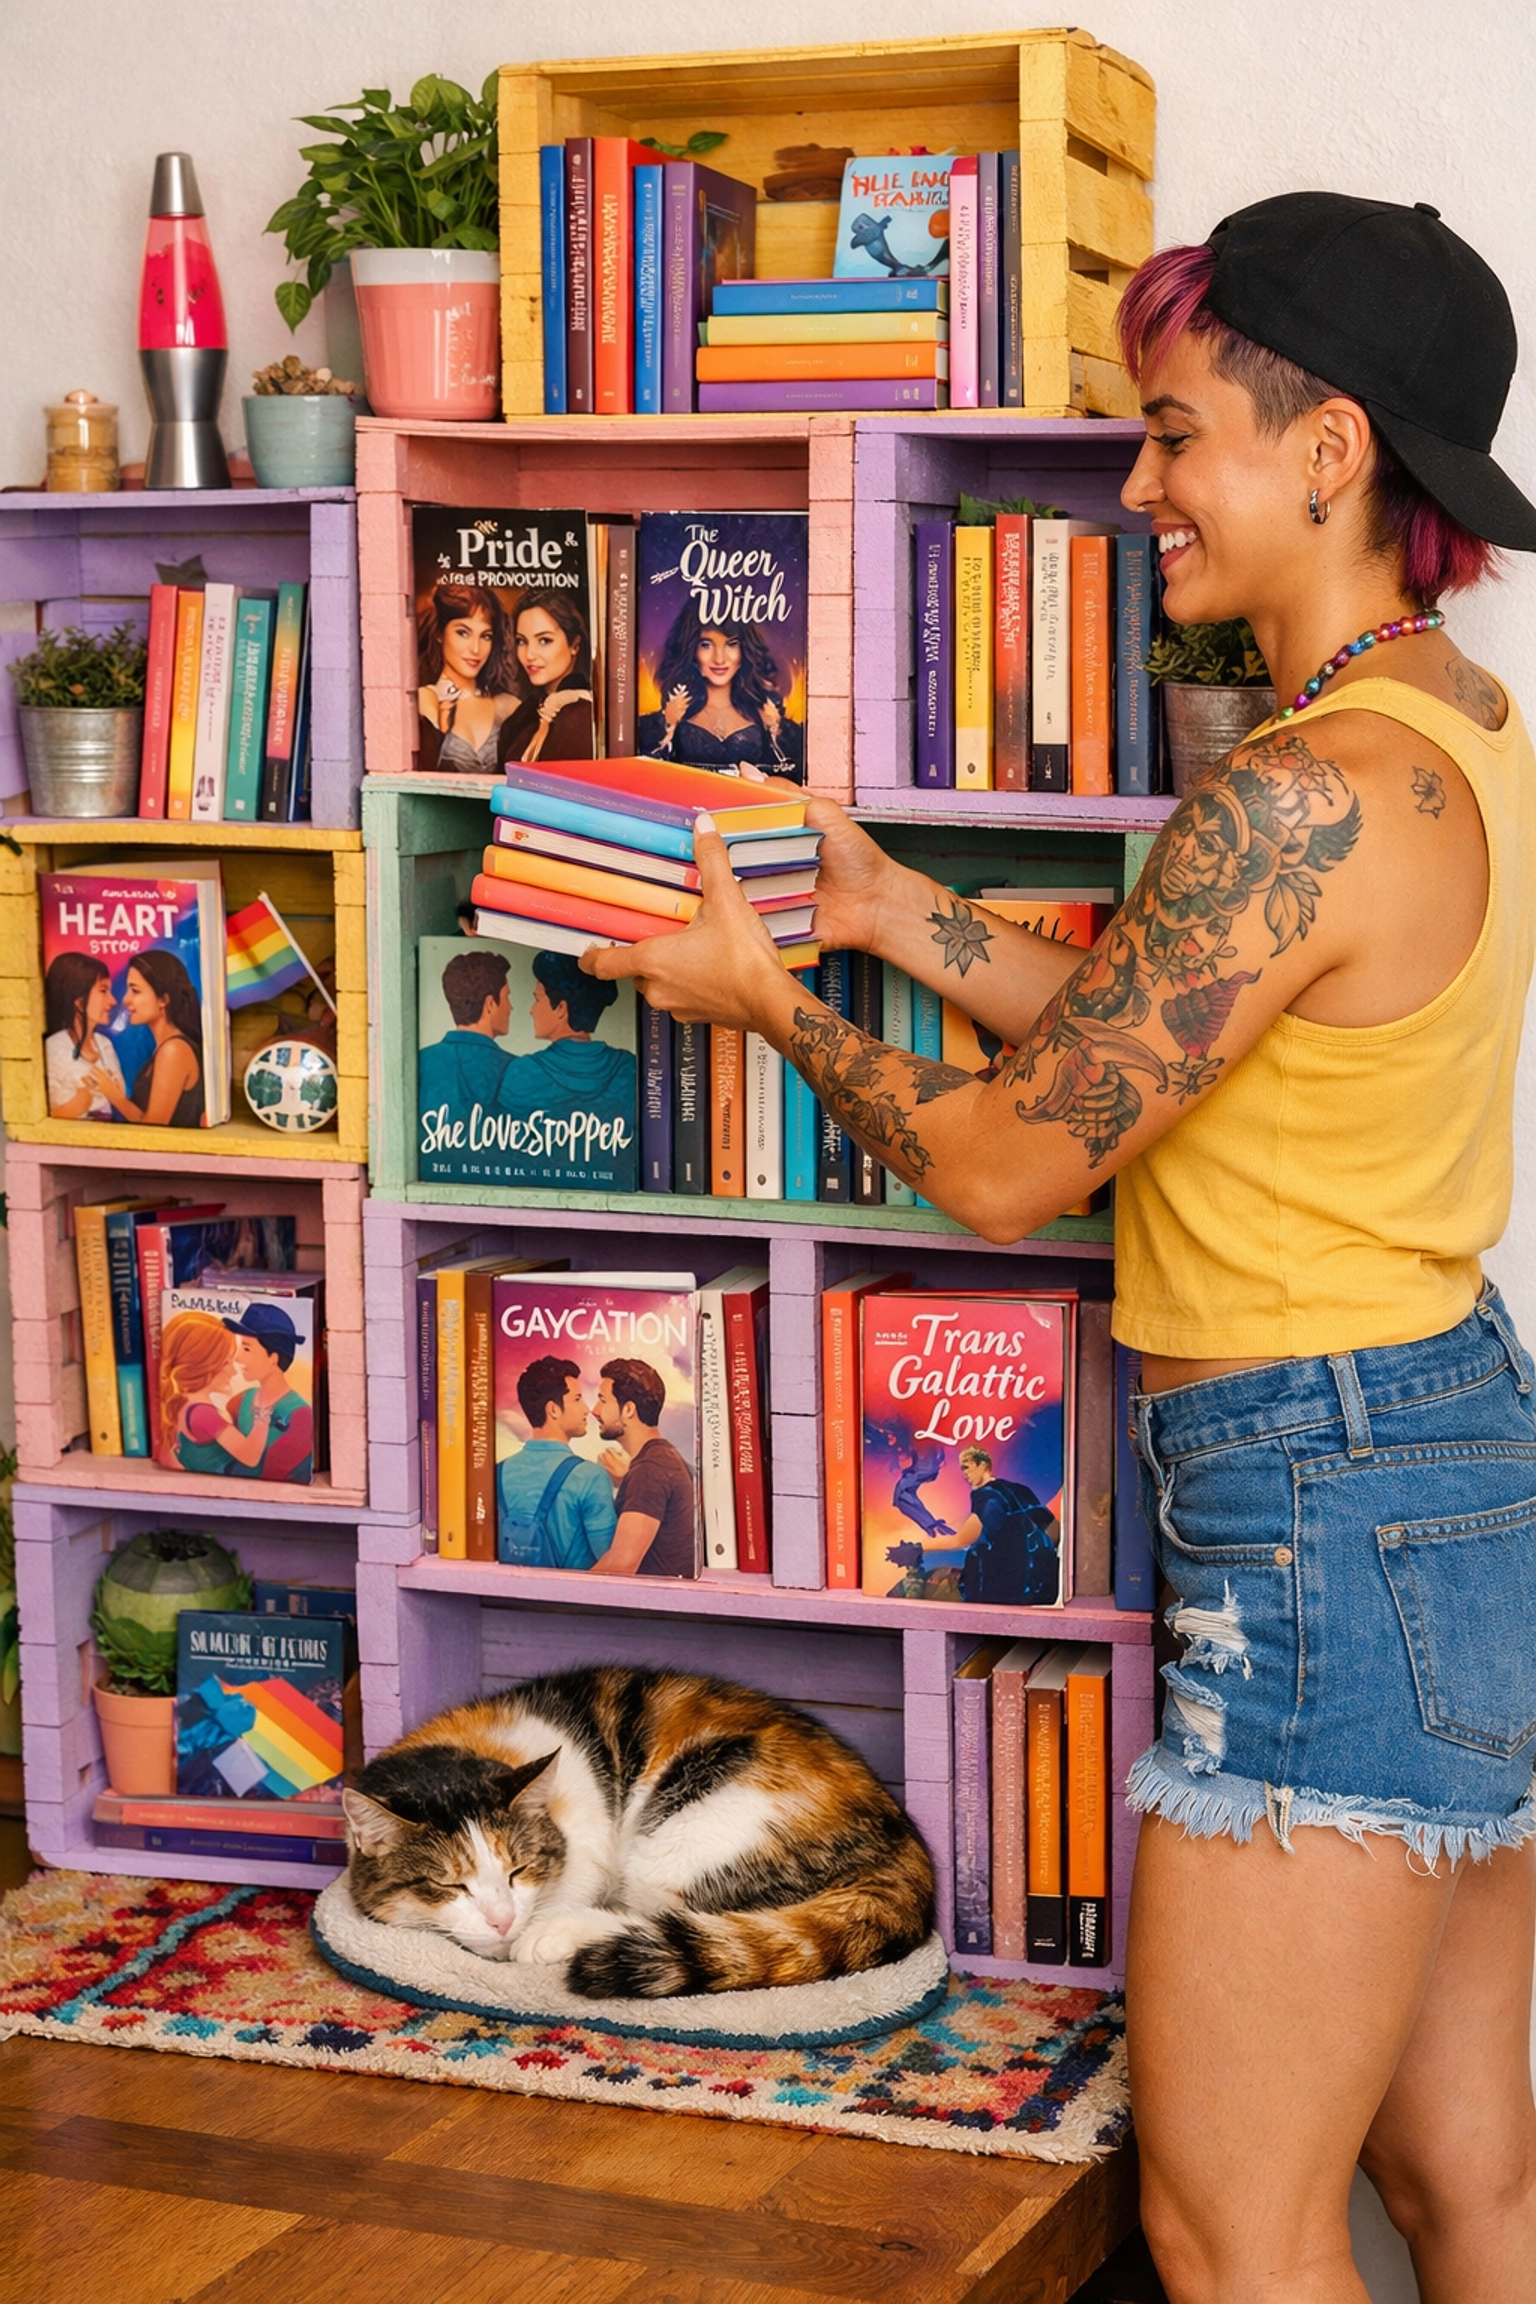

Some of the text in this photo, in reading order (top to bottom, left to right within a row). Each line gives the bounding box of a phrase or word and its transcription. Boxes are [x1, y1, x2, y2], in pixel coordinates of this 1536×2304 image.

[456, 527, 563, 569] Pride
[684, 524, 720, 542] The
[477, 571, 579, 588] PROVOCATION
[680, 540, 778, 587] Queer
[690, 572, 793, 625] Witch
[59, 902, 179, 938] HEART
[501, 1305, 687, 1347] GAYCATION
[911, 1312, 1025, 1357] Trans
[914, 1398, 1017, 1446] Love
